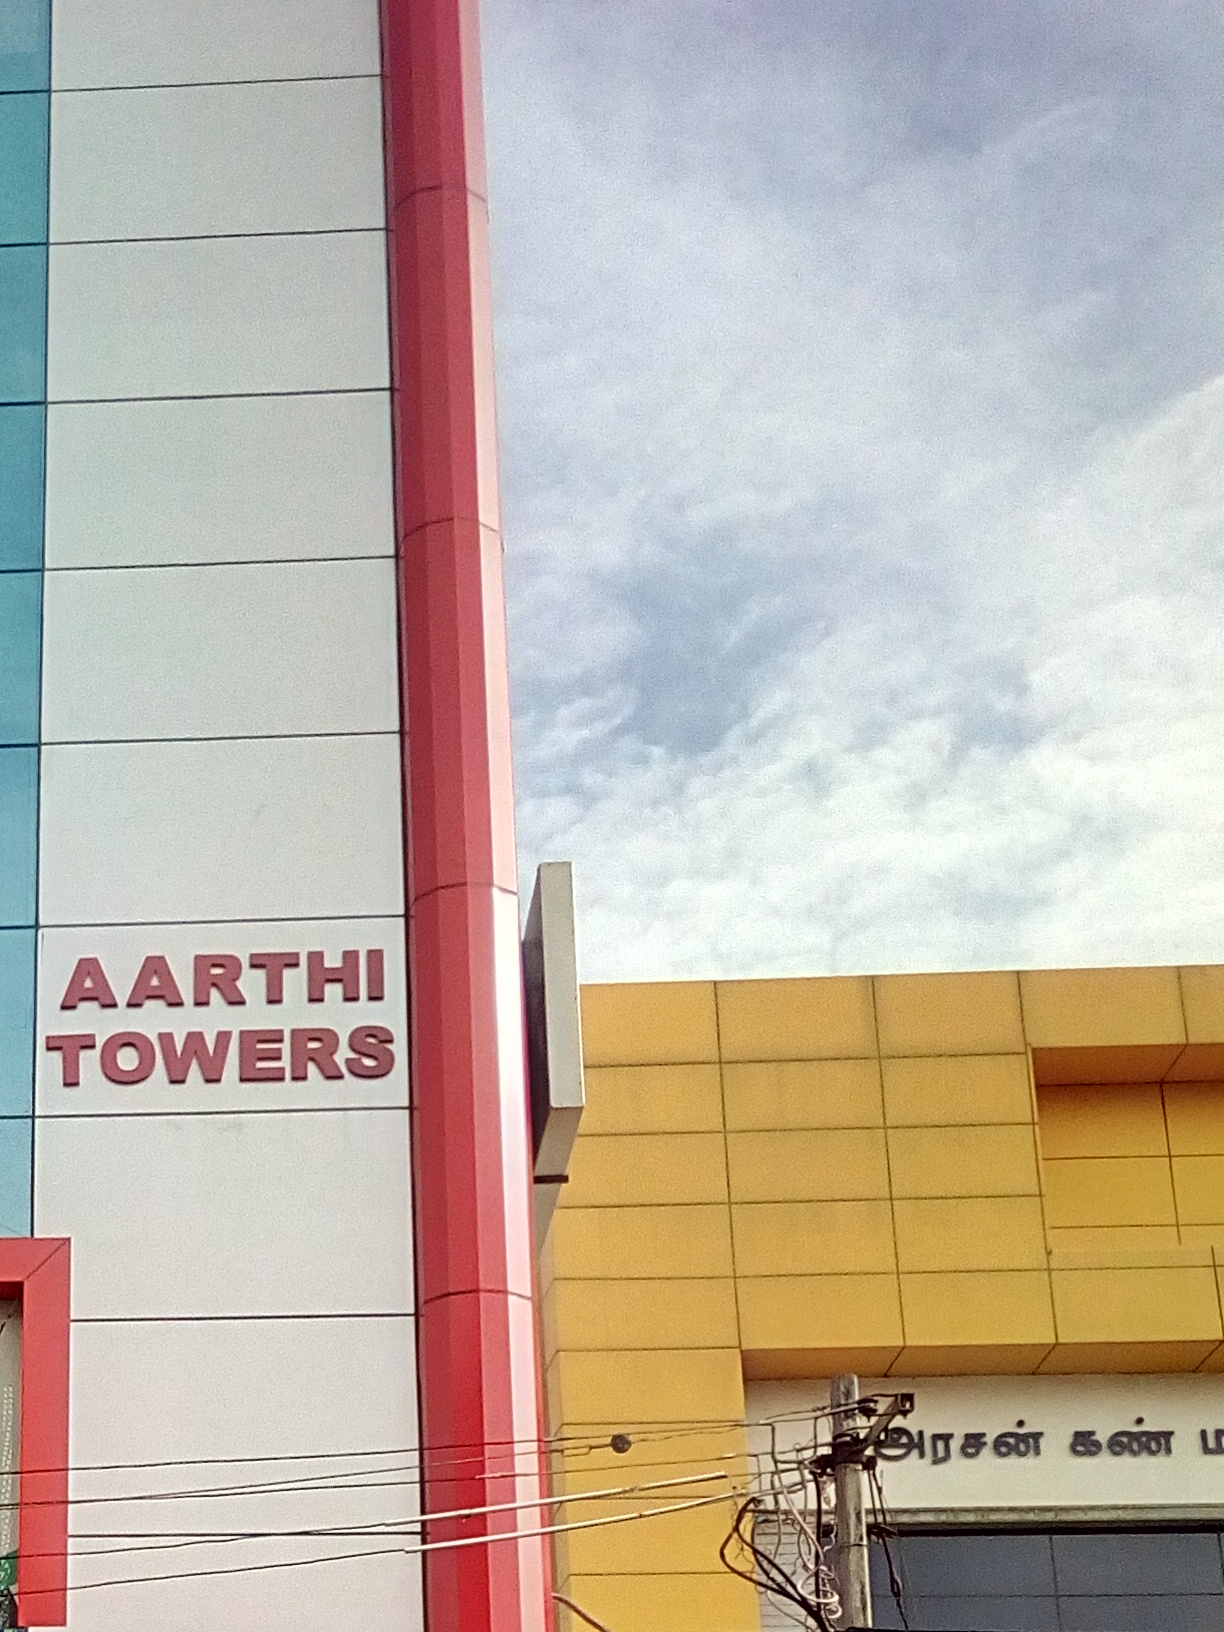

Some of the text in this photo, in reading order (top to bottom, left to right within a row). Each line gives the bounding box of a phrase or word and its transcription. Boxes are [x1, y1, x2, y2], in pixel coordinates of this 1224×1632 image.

[60, 949, 385, 1010] AARTHI
[45, 1025, 395, 1087] TOWERS
[875, 1419, 1044, 1465] அரசன்
[1069, 1416, 1174, 1457] கண்
